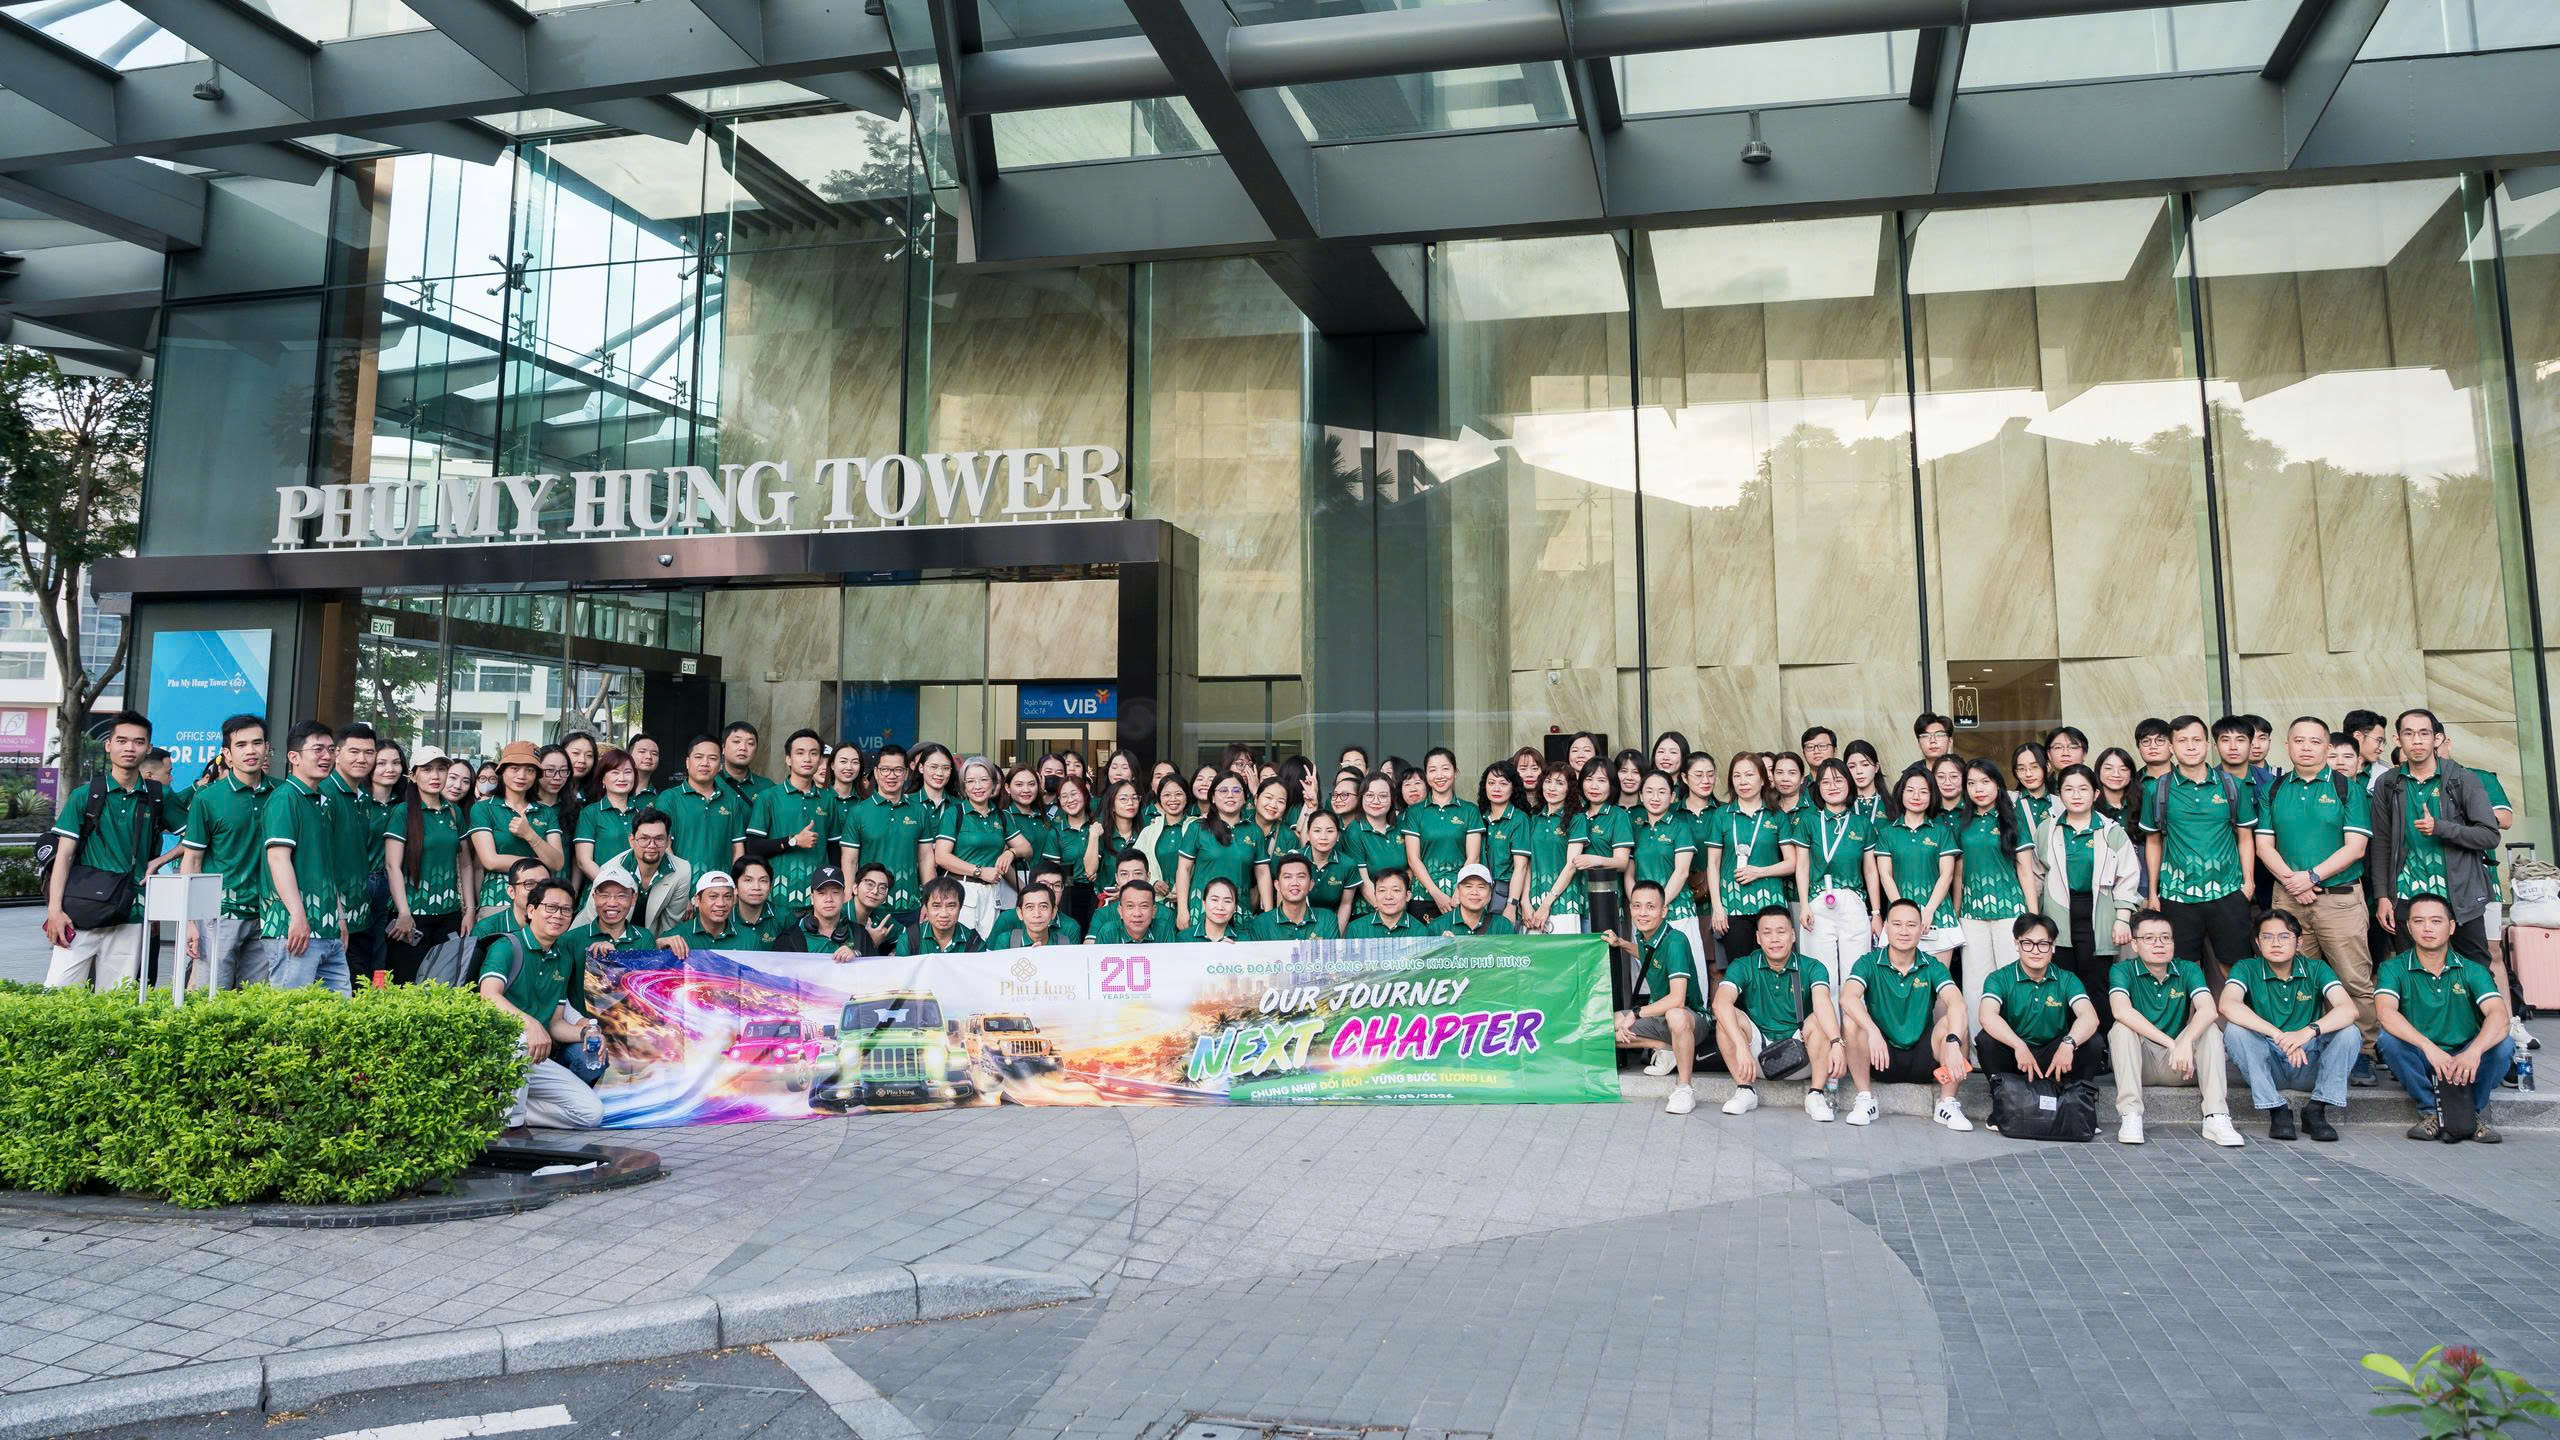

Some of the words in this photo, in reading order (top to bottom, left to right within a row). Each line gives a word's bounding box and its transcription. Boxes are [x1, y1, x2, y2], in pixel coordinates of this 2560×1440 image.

[272, 481, 427, 544] PHU
[432, 474, 560, 537] MY
[567, 460, 798, 533] HUNG
[815, 445, 1130, 522] TOWER
[373, 622, 393, 634] EXIT
[683, 662, 696, 673] EXIT
[168, 679, 179, 687] Phu
[181, 679, 190, 688] My
[192, 679, 208, 688] Hung
[210, 679, 227, 687] Tower
[1063, 699, 1097, 714] VIB
[176, 731, 204, 741] OFFICE
[858, 736, 883, 749] VIB
[198, 746, 223, 763] LE
[1100, 956, 1151, 992] 20
[1206, 962, 1243, 975] CÔNG
[1247, 962, 1282, 974] ĐOÀN
[1325, 959, 1363, 972] CÔNG
[1365, 960, 1380, 971] TY
[1427, 956, 1470, 970] KHOÁN
[1258, 985, 1320, 1014] OUR
[1329, 977, 1470, 1012] JOURNEY
[1188, 1020, 1325, 1081] NEXT
[1330, 1009, 1545, 1065] CHAPTER
[1251, 1086, 1289, 1098] CHUNG
[1291, 1082, 1317, 1094] NHỊP
[1480, 1074, 1496, 1083] LAI
